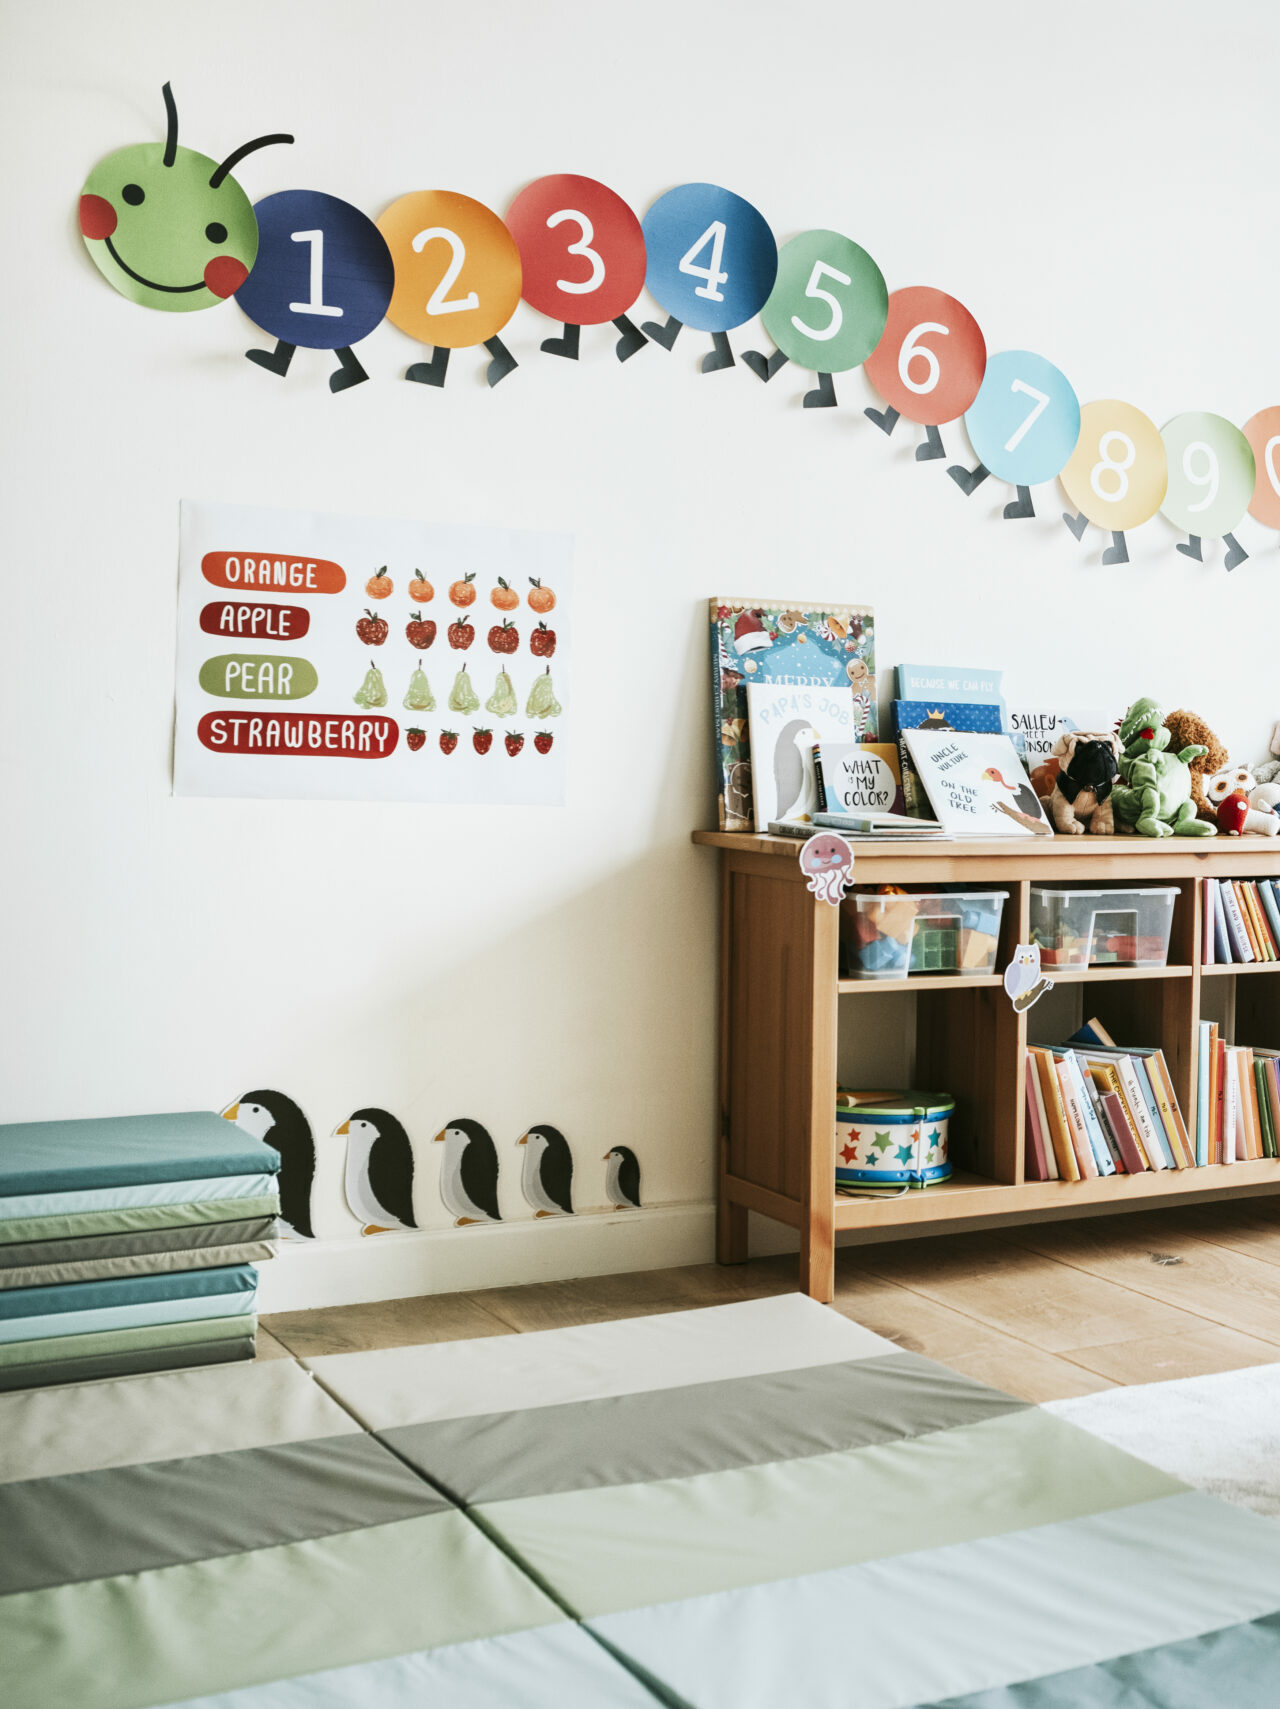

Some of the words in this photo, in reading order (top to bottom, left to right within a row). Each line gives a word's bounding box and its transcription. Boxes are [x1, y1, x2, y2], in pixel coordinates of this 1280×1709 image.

[288, 229, 344, 318] 1
[411, 227, 480, 317] 2
[546, 208, 606, 295] 3
[678, 219, 728, 303] 4
[791, 259, 852, 341] 5
[898, 321, 949, 395] 6
[1004, 378, 1050, 453] 7
[1089, 430, 1136, 503] 8
[1181, 441, 1220, 513] 9
[225, 556, 318, 589] ORANGE
[219, 605, 292, 637] APPLE
[224, 661, 294, 695] PEAR
[911, 677, 945, 689] BECAUSE
[947, 679, 960, 690] WE
[963, 681, 979, 692] CAN
[980, 681, 995, 692] FLY
[760, 693, 812, 725] PAPA'S
[818, 697, 849, 725] JOB
[1011, 713, 1056, 731] SALLEY
[209, 718, 389, 753] STRAWBERRY
[1022, 730, 1045, 739] MEET
[930, 742, 959, 763] UNCLE
[842, 759, 881, 774] WHAT
[937, 751, 969, 772] VULTURE
[856, 775, 875, 790] MY
[941, 780, 956, 790] ON
[961, 785, 979, 797] THE
[844, 791, 889, 806] COLOR?
[950, 791, 972, 804] OLD
[948, 799, 977, 814] TREE
[1108, 1069, 1117, 1085] THE
